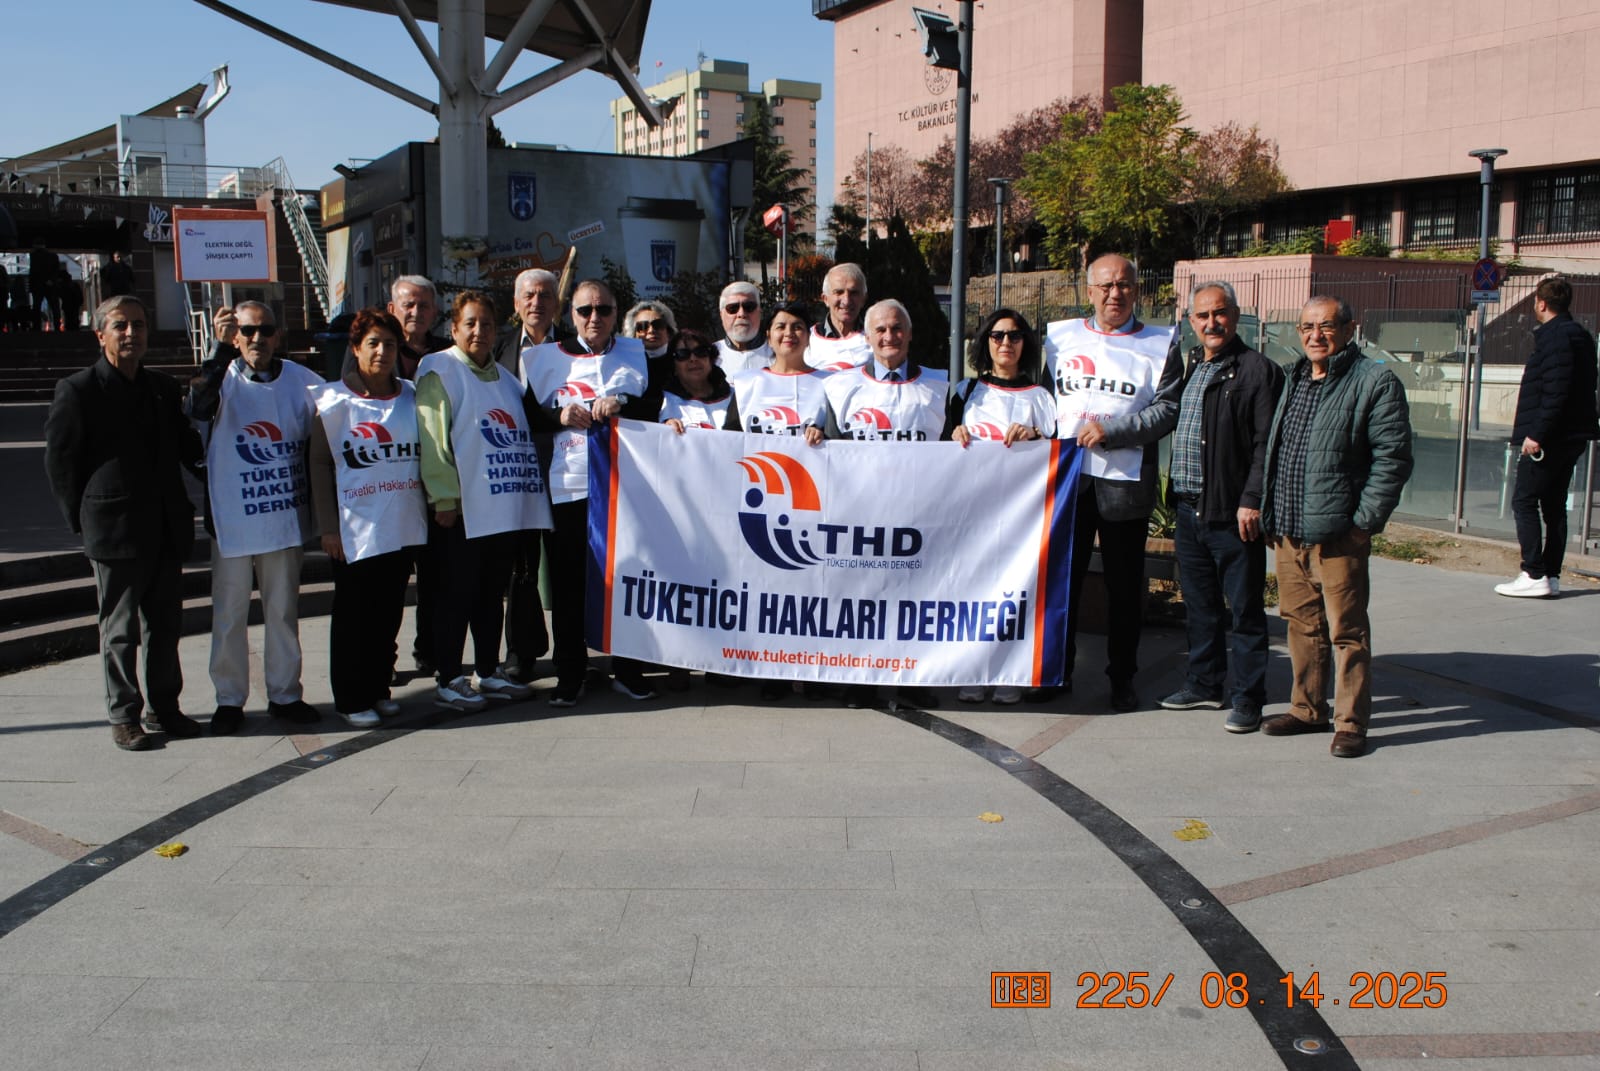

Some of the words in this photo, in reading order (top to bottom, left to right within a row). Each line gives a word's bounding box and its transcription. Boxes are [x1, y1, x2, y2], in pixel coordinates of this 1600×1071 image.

[911, 102, 937, 119] KÜLTÜR
[939, 100, 948, 112] VE
[205, 241, 234, 249] ELEKTRİK
[235, 240, 254, 248] DEĞİL
[230, 252, 253, 261] ÇARPTI
[1083, 376, 1136, 395] THD
[817, 523, 923, 557] THD
[826, 557, 858, 569] TÜKETİCİ
[859, 559, 889, 569] HAKLARI
[890, 559, 922, 570] DERNEĞİ
[622, 569, 749, 632] TÜKETİCİ
[758, 592, 887, 641] HAKLARI
[897, 590, 1028, 642] DERNEĞİ
[722, 646, 918, 673] www.tuketicihaklari.org.tr
